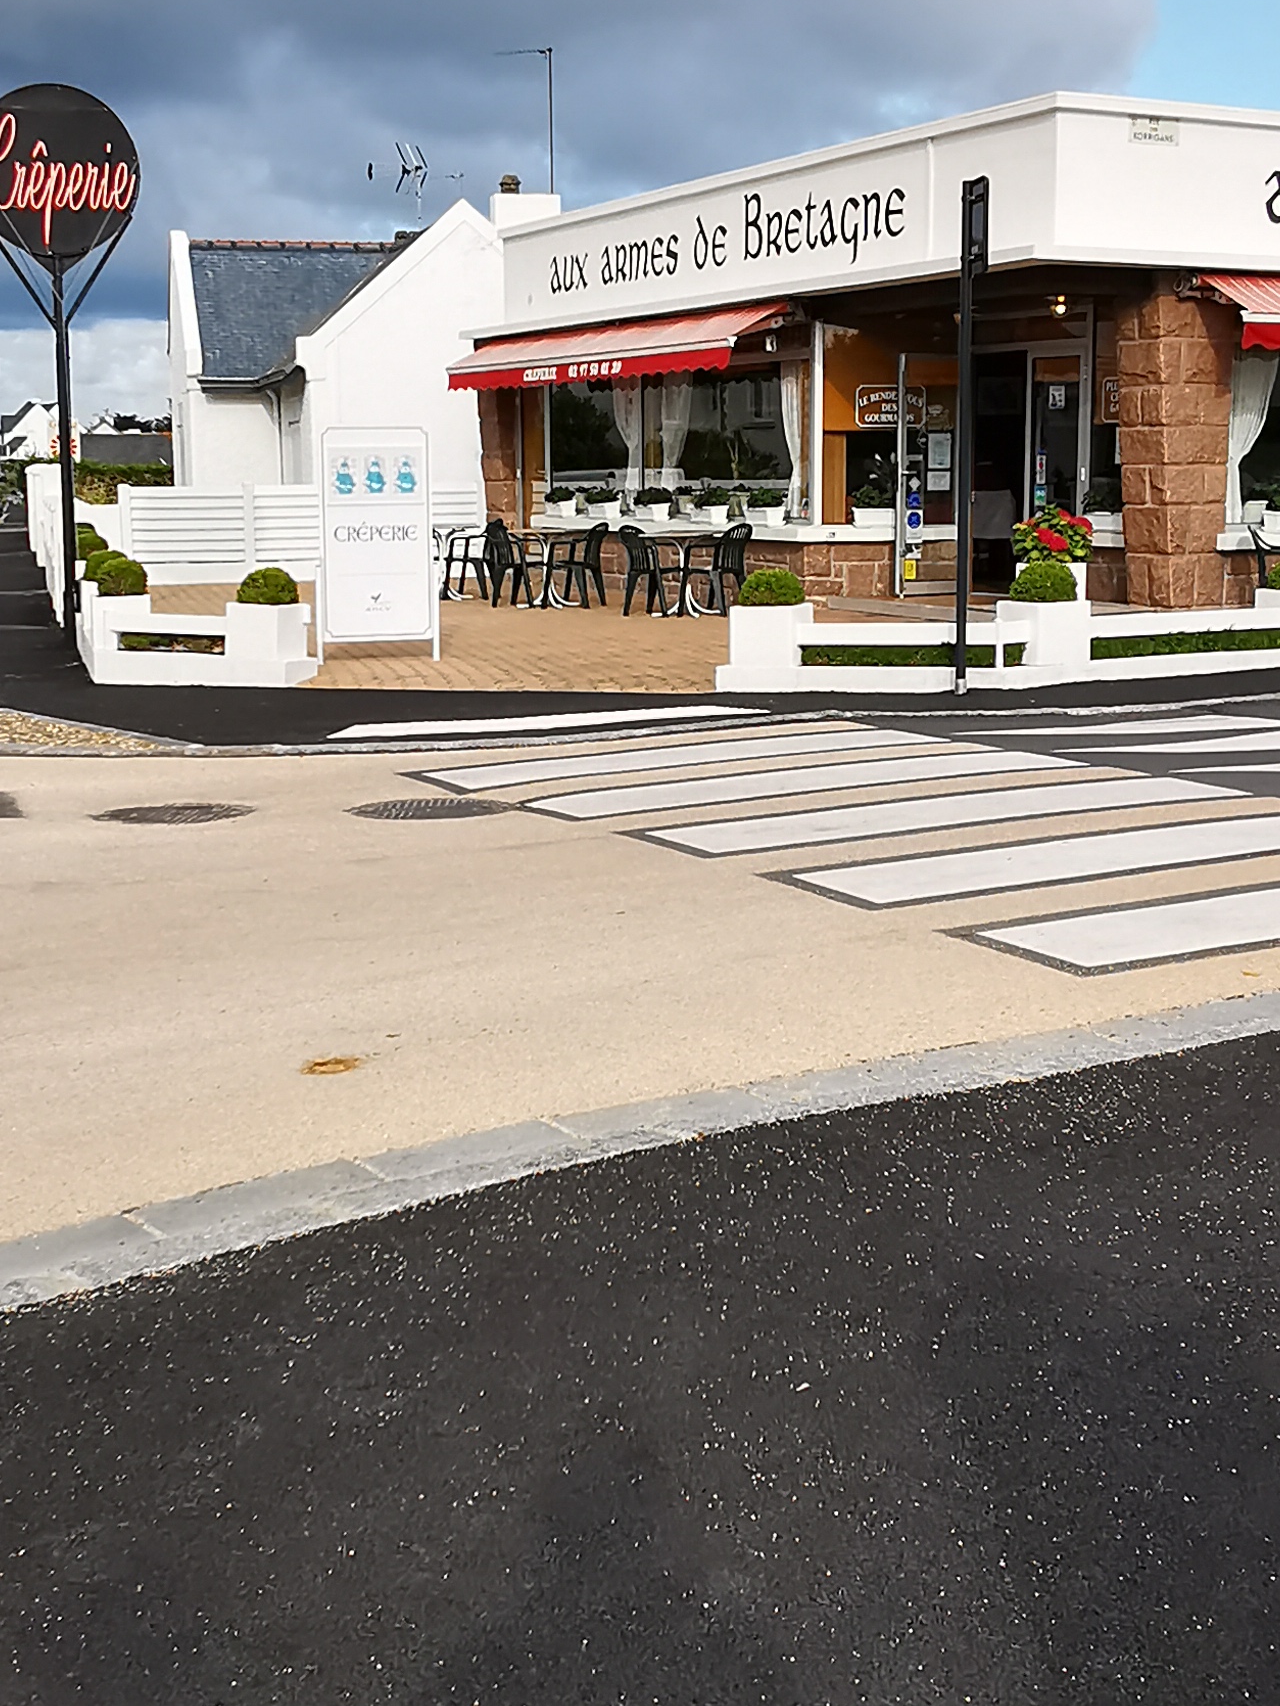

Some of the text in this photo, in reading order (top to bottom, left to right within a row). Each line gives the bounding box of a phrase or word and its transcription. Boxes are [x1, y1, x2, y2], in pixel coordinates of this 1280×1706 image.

[550, 188, 906, 294] aux armes de Bretagne
[881, 403, 898, 412] DES
[333, 520, 419, 543] CRÉPERIE
